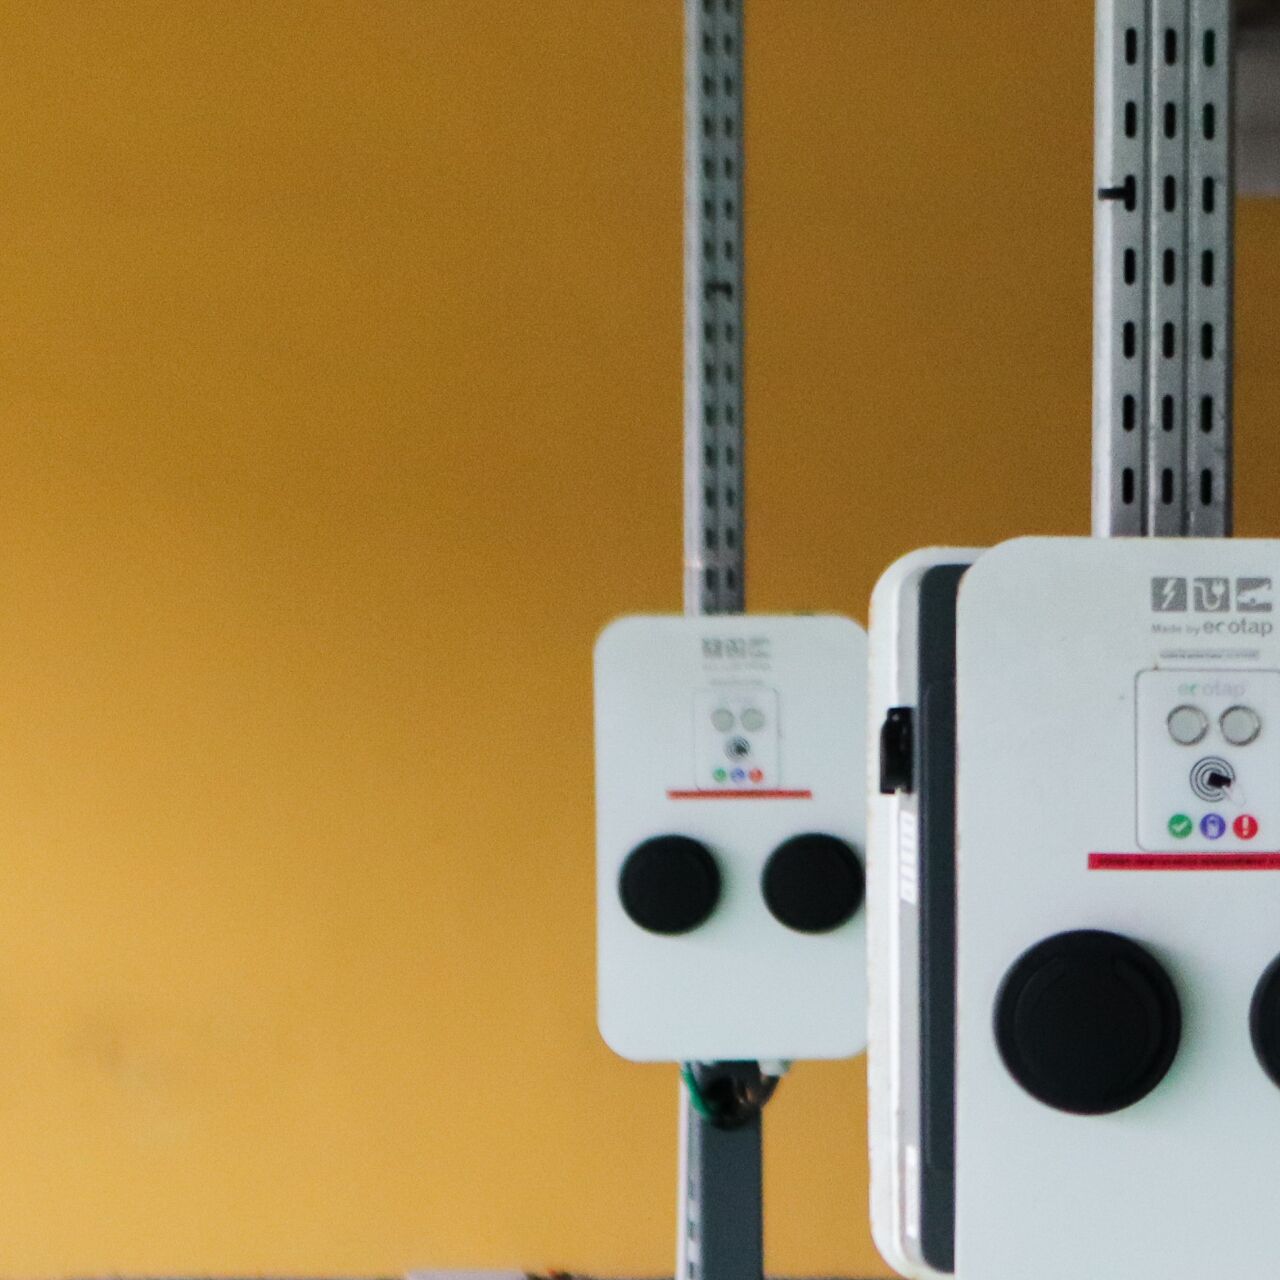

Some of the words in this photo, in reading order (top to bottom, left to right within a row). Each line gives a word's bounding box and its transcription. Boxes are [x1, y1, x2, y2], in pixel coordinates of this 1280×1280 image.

[1186, 624, 1200, 636] by
[1203, 618, 1273, 637] ecotap
[1178, 681, 1245, 698] ecotap
